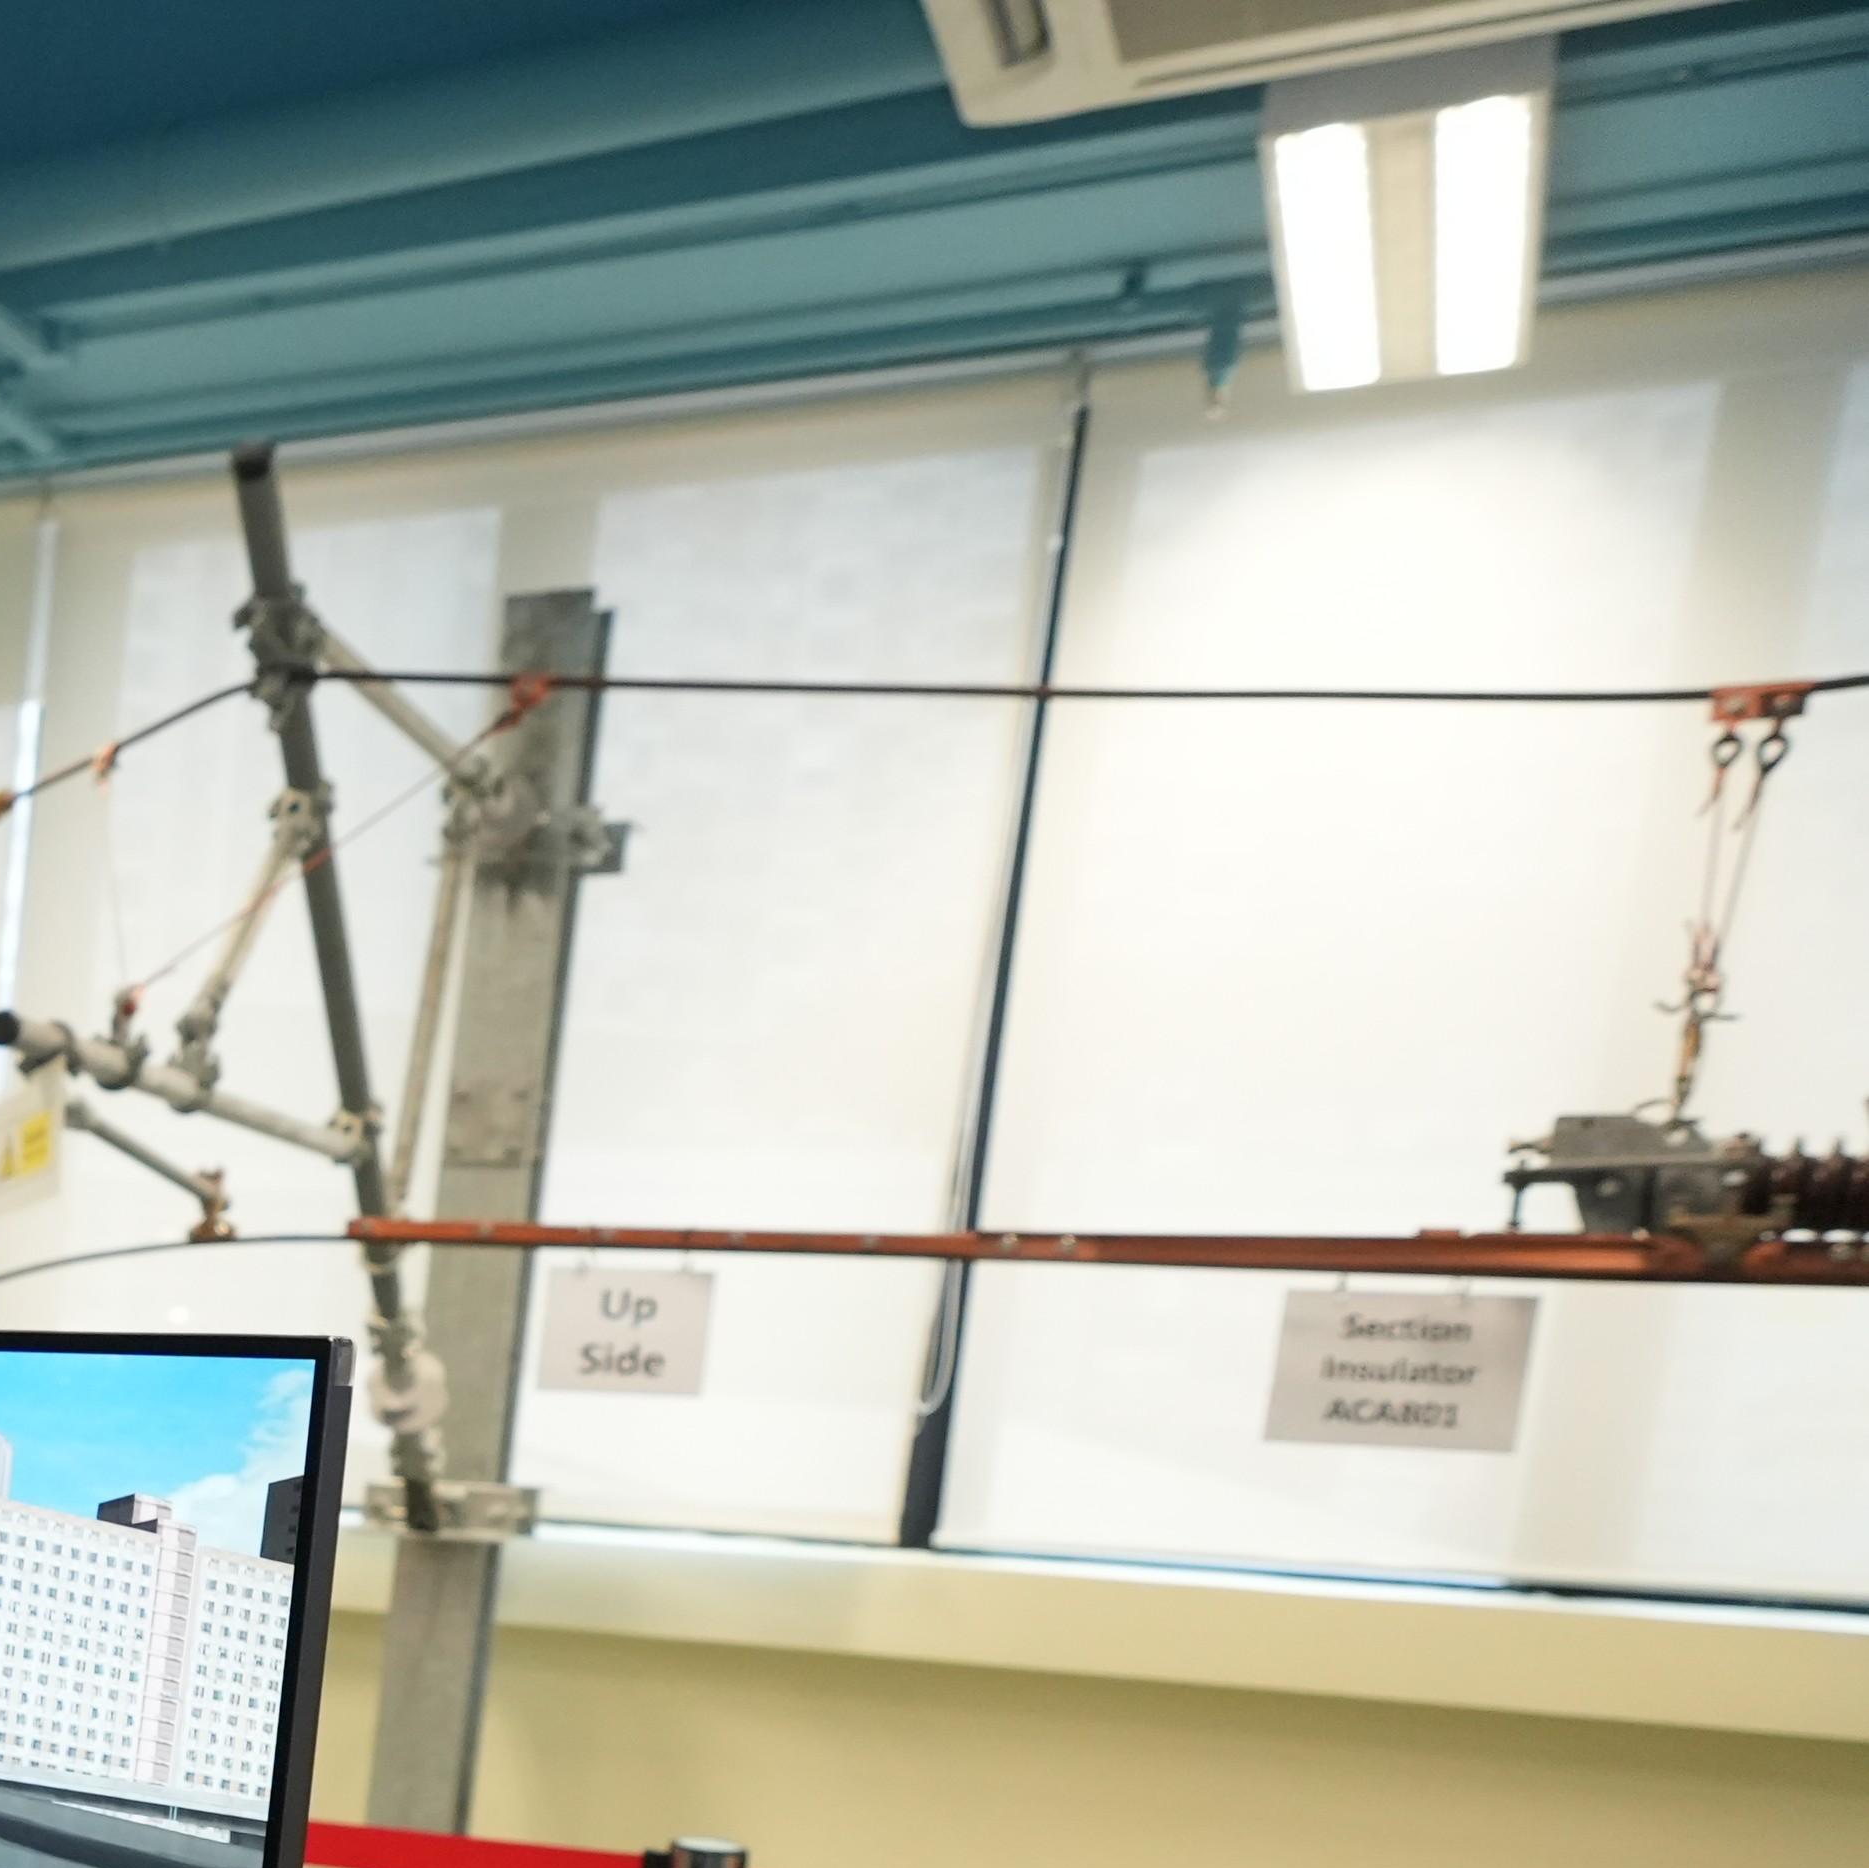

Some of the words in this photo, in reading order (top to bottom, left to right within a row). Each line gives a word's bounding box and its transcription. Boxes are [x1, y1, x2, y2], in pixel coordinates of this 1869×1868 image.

[600, 1287, 658, 1329] Up
[1340, 1312, 1473, 1343] Section
[578, 1341, 666, 1377] Side
[1319, 1354, 1479, 1386] Insulator
